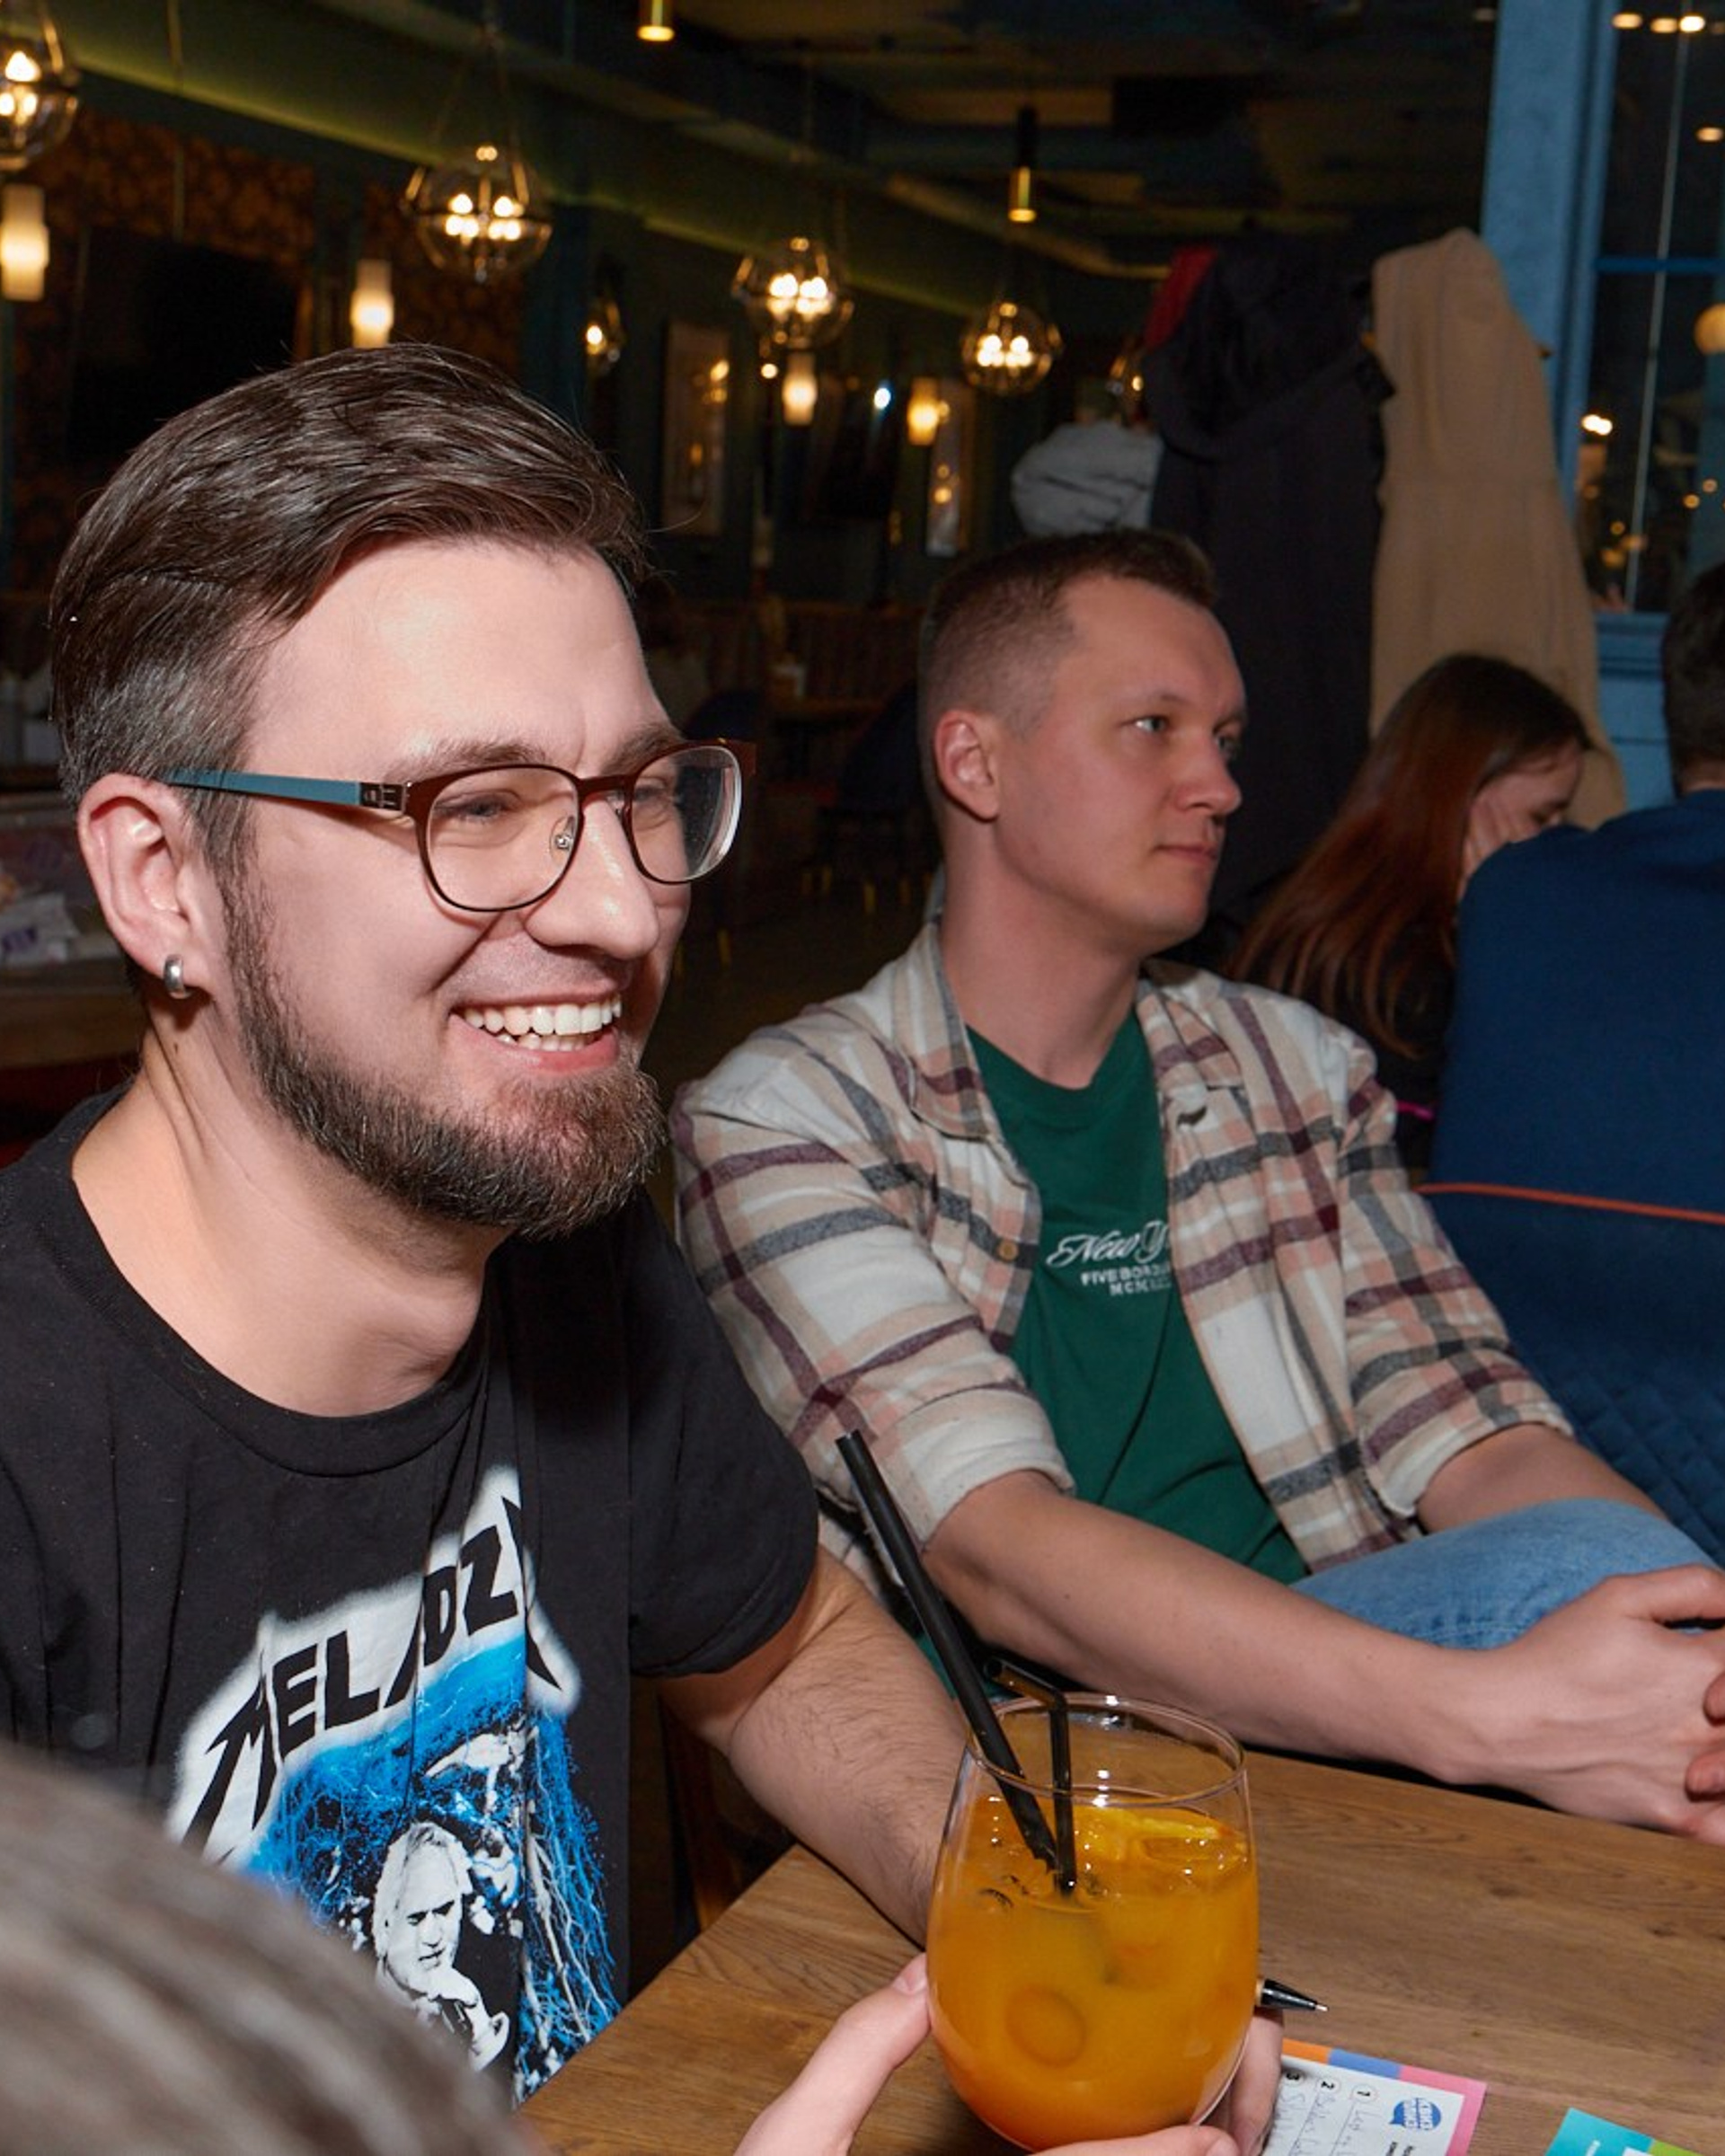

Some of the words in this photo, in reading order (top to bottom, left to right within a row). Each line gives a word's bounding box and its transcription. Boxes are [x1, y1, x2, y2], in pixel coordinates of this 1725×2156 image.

[1046, 1231, 1139, 1268] New
[1081, 1268, 1118, 1286] FIVE
[1321, 2081, 1335, 2090] 2
